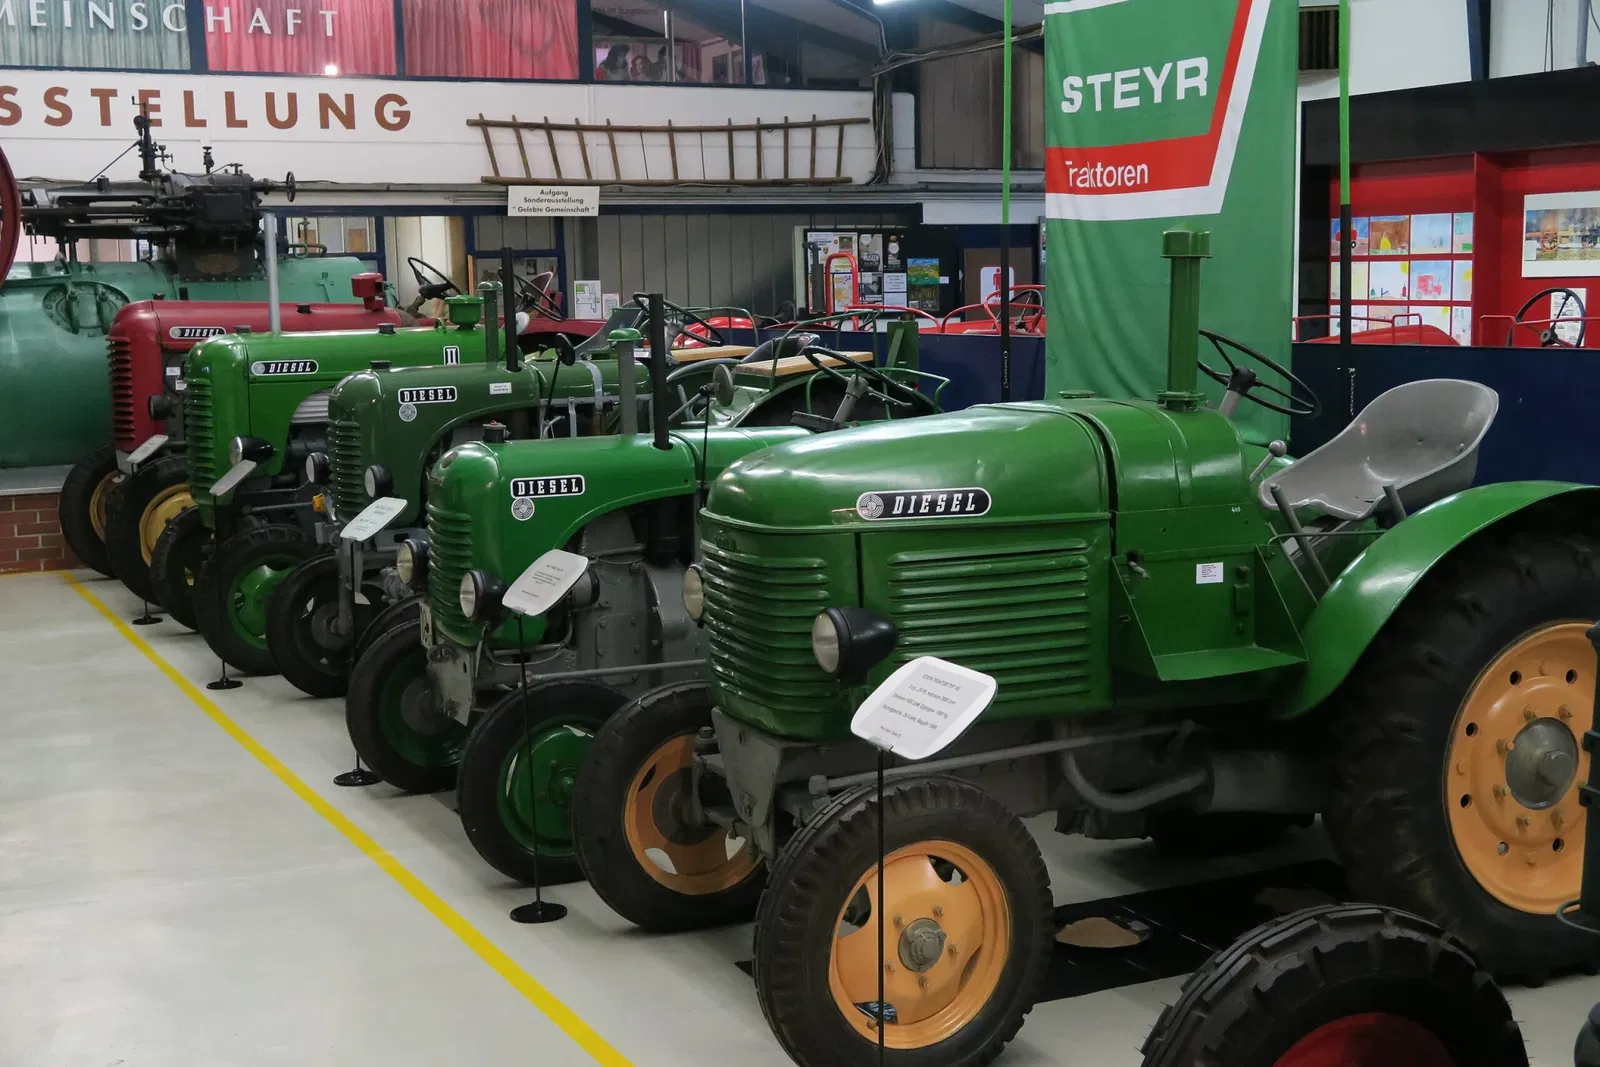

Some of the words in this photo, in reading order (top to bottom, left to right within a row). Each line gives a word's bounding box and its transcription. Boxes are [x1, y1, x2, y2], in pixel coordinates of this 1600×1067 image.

[1061, 56, 1208, 113] STEYR
[0, 85, 411, 131] SSTELLUNG
[540, 189, 569, 197] Aufgang
[524, 196, 584, 204] Sonderausstellung
[184, 328, 219, 337] DIESEL
[269, 362, 311, 373] DIESEL
[403, 389, 452, 402] DIESEL
[517, 478, 579, 496] DIESEL
[892, 493, 975, 514] DIESEL
